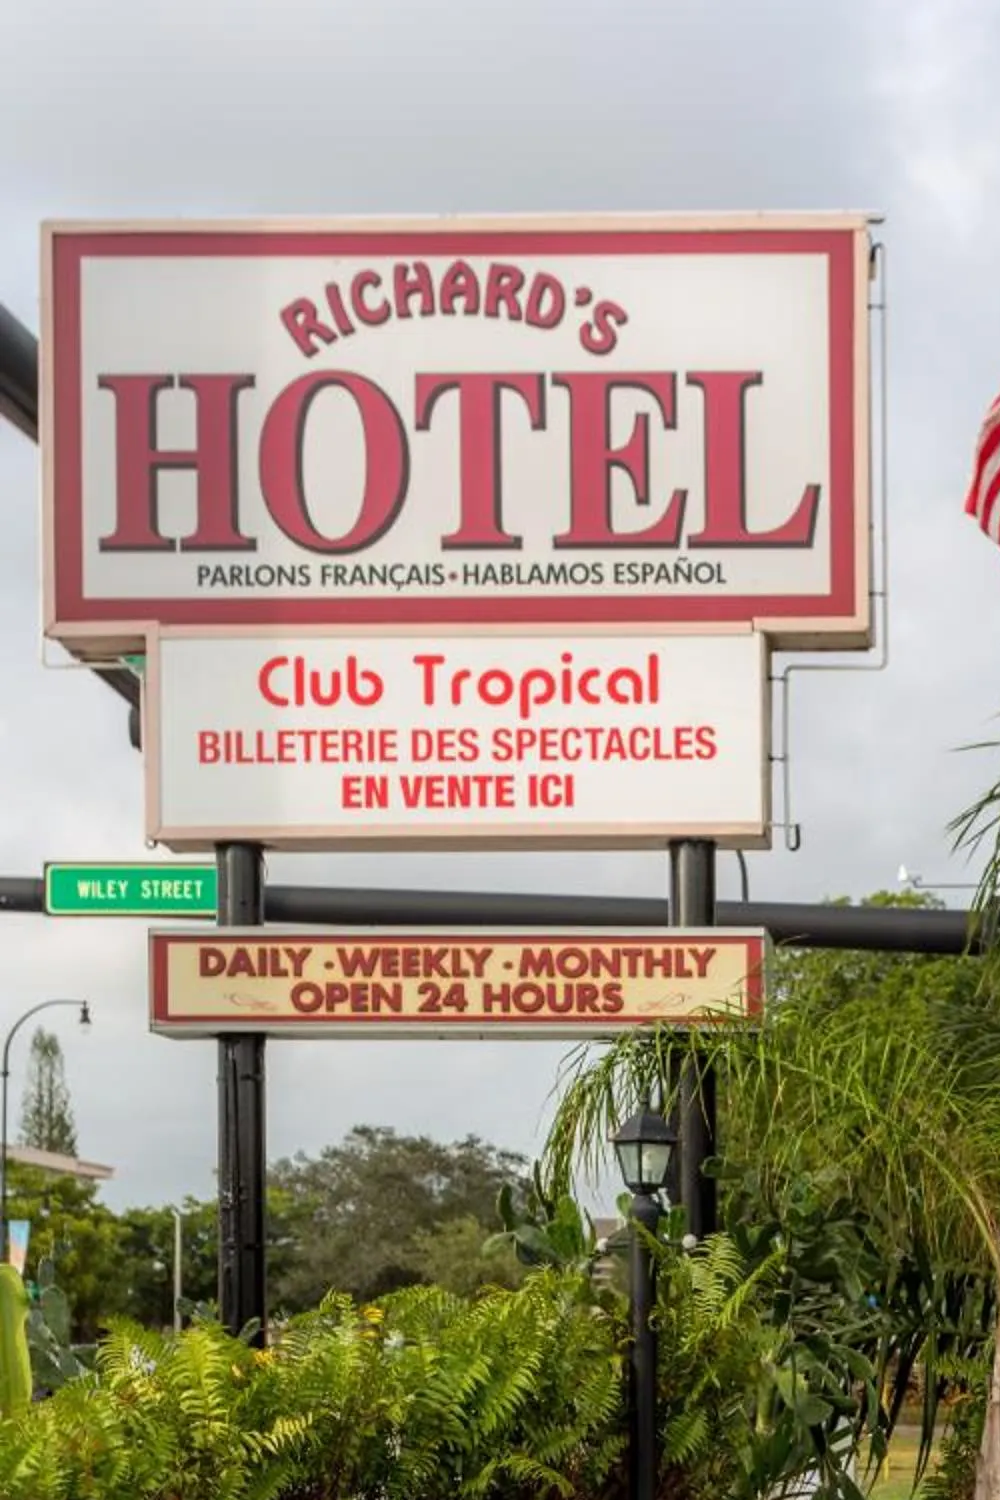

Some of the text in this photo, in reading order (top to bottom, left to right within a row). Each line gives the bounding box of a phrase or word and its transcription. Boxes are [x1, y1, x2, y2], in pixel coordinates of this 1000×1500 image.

[280, 260, 629, 358] RICHARD'S
[97, 368, 822, 556] HOTEL
[197, 557, 727, 591] PARLONS FRANÇAIS HABLAMOS ESPAÑOL
[258, 652, 660, 720] Club Tropical
[198, 726, 718, 764] BILLETERIE DES SPECTACLES
[341, 773, 575, 809] EN VENTE ICI
[77, 879, 204, 899] WILEY STREET
[199, 947, 313, 978] DAILY
[290, 981, 625, 1014] OPEN 24 HOURS
